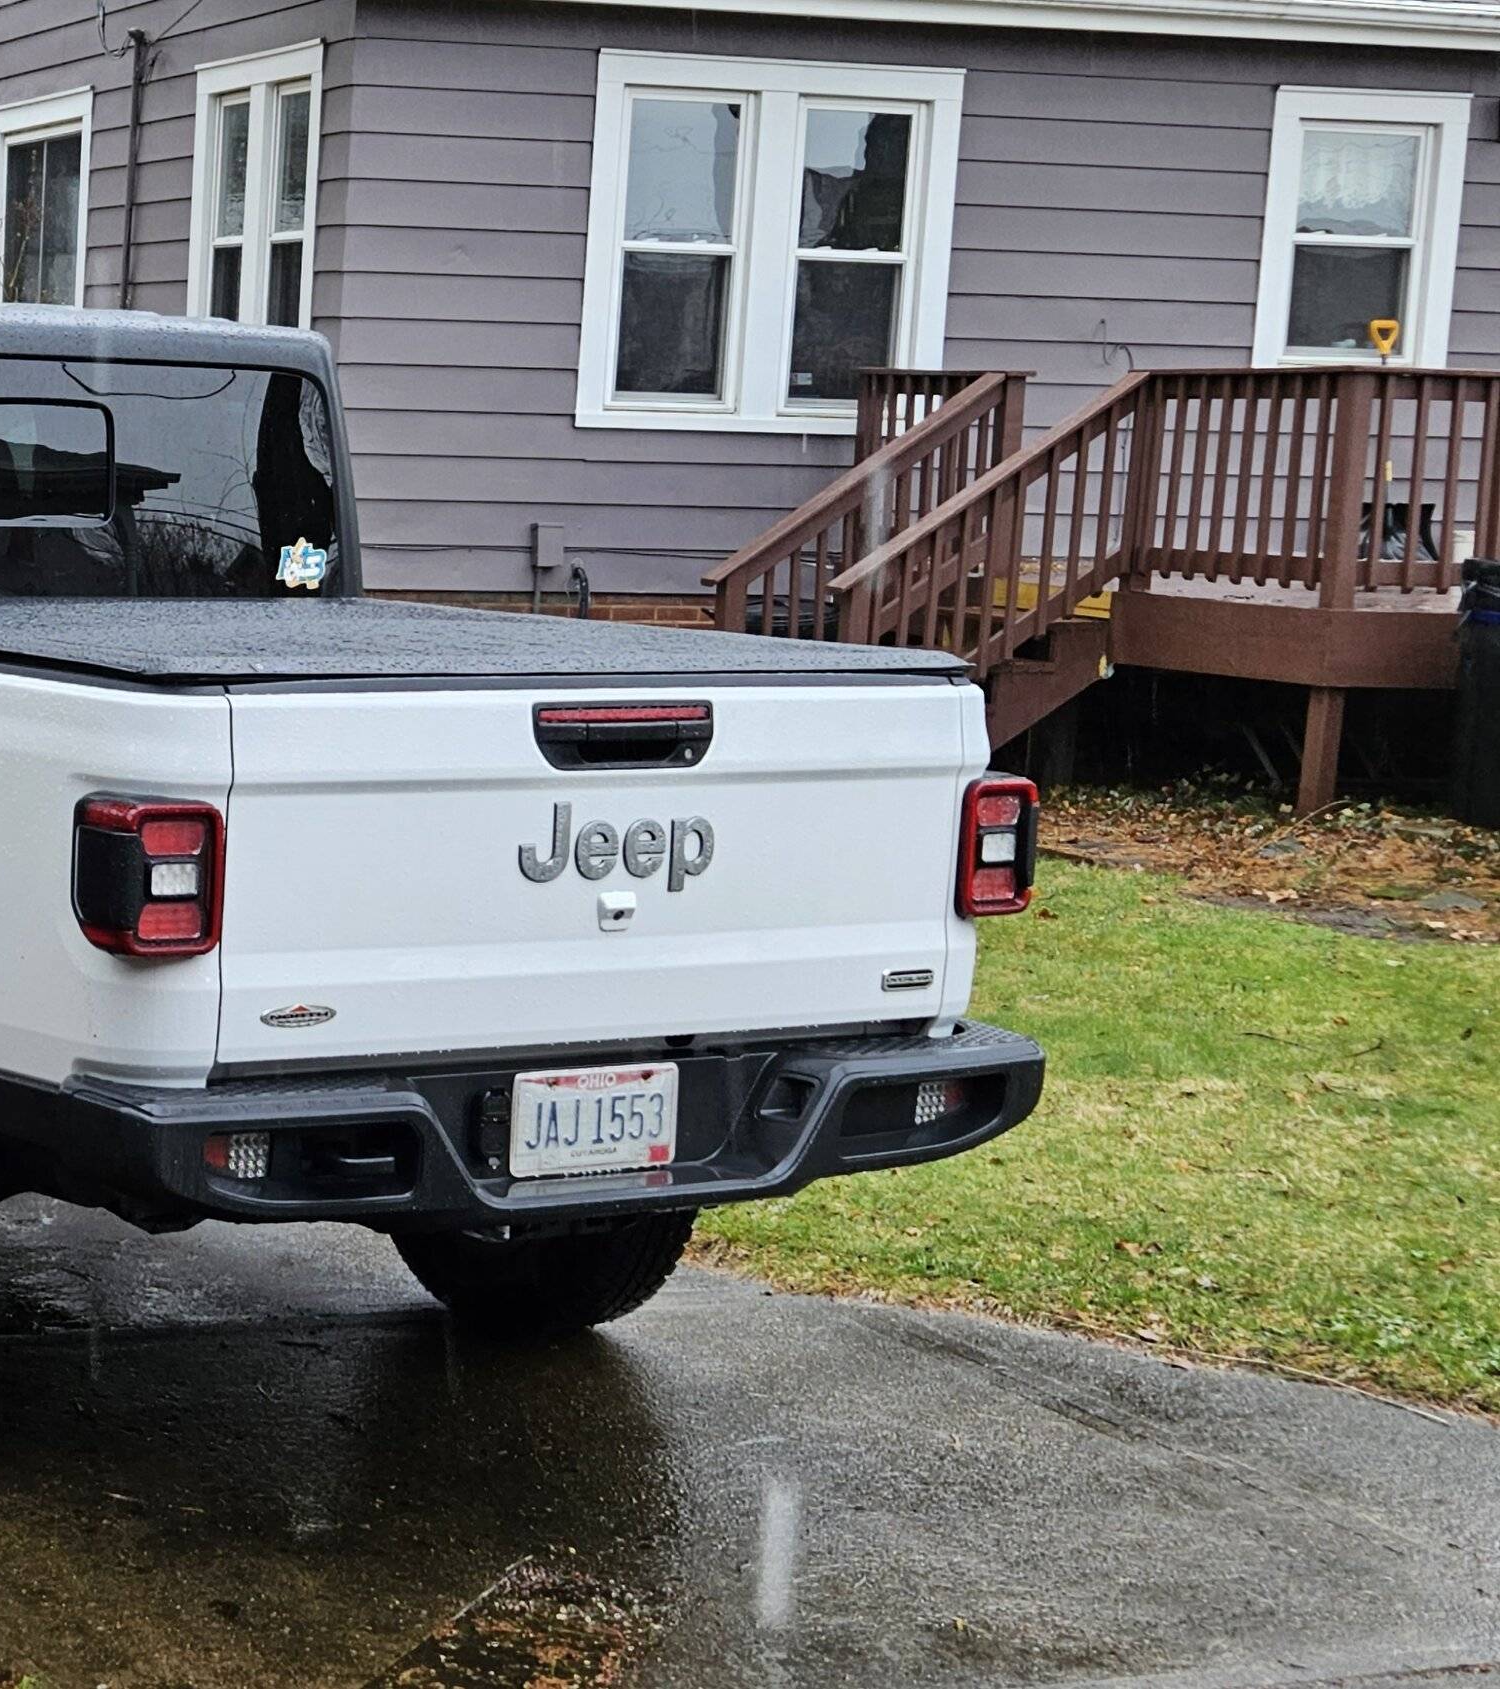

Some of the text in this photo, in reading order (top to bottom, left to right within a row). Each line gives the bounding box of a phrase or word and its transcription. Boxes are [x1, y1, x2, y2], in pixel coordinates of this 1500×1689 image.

[518, 801, 715, 892] Jeep
[576, 1072, 617, 1089] OHIO
[524, 1092, 665, 1150] JAJ 1553
